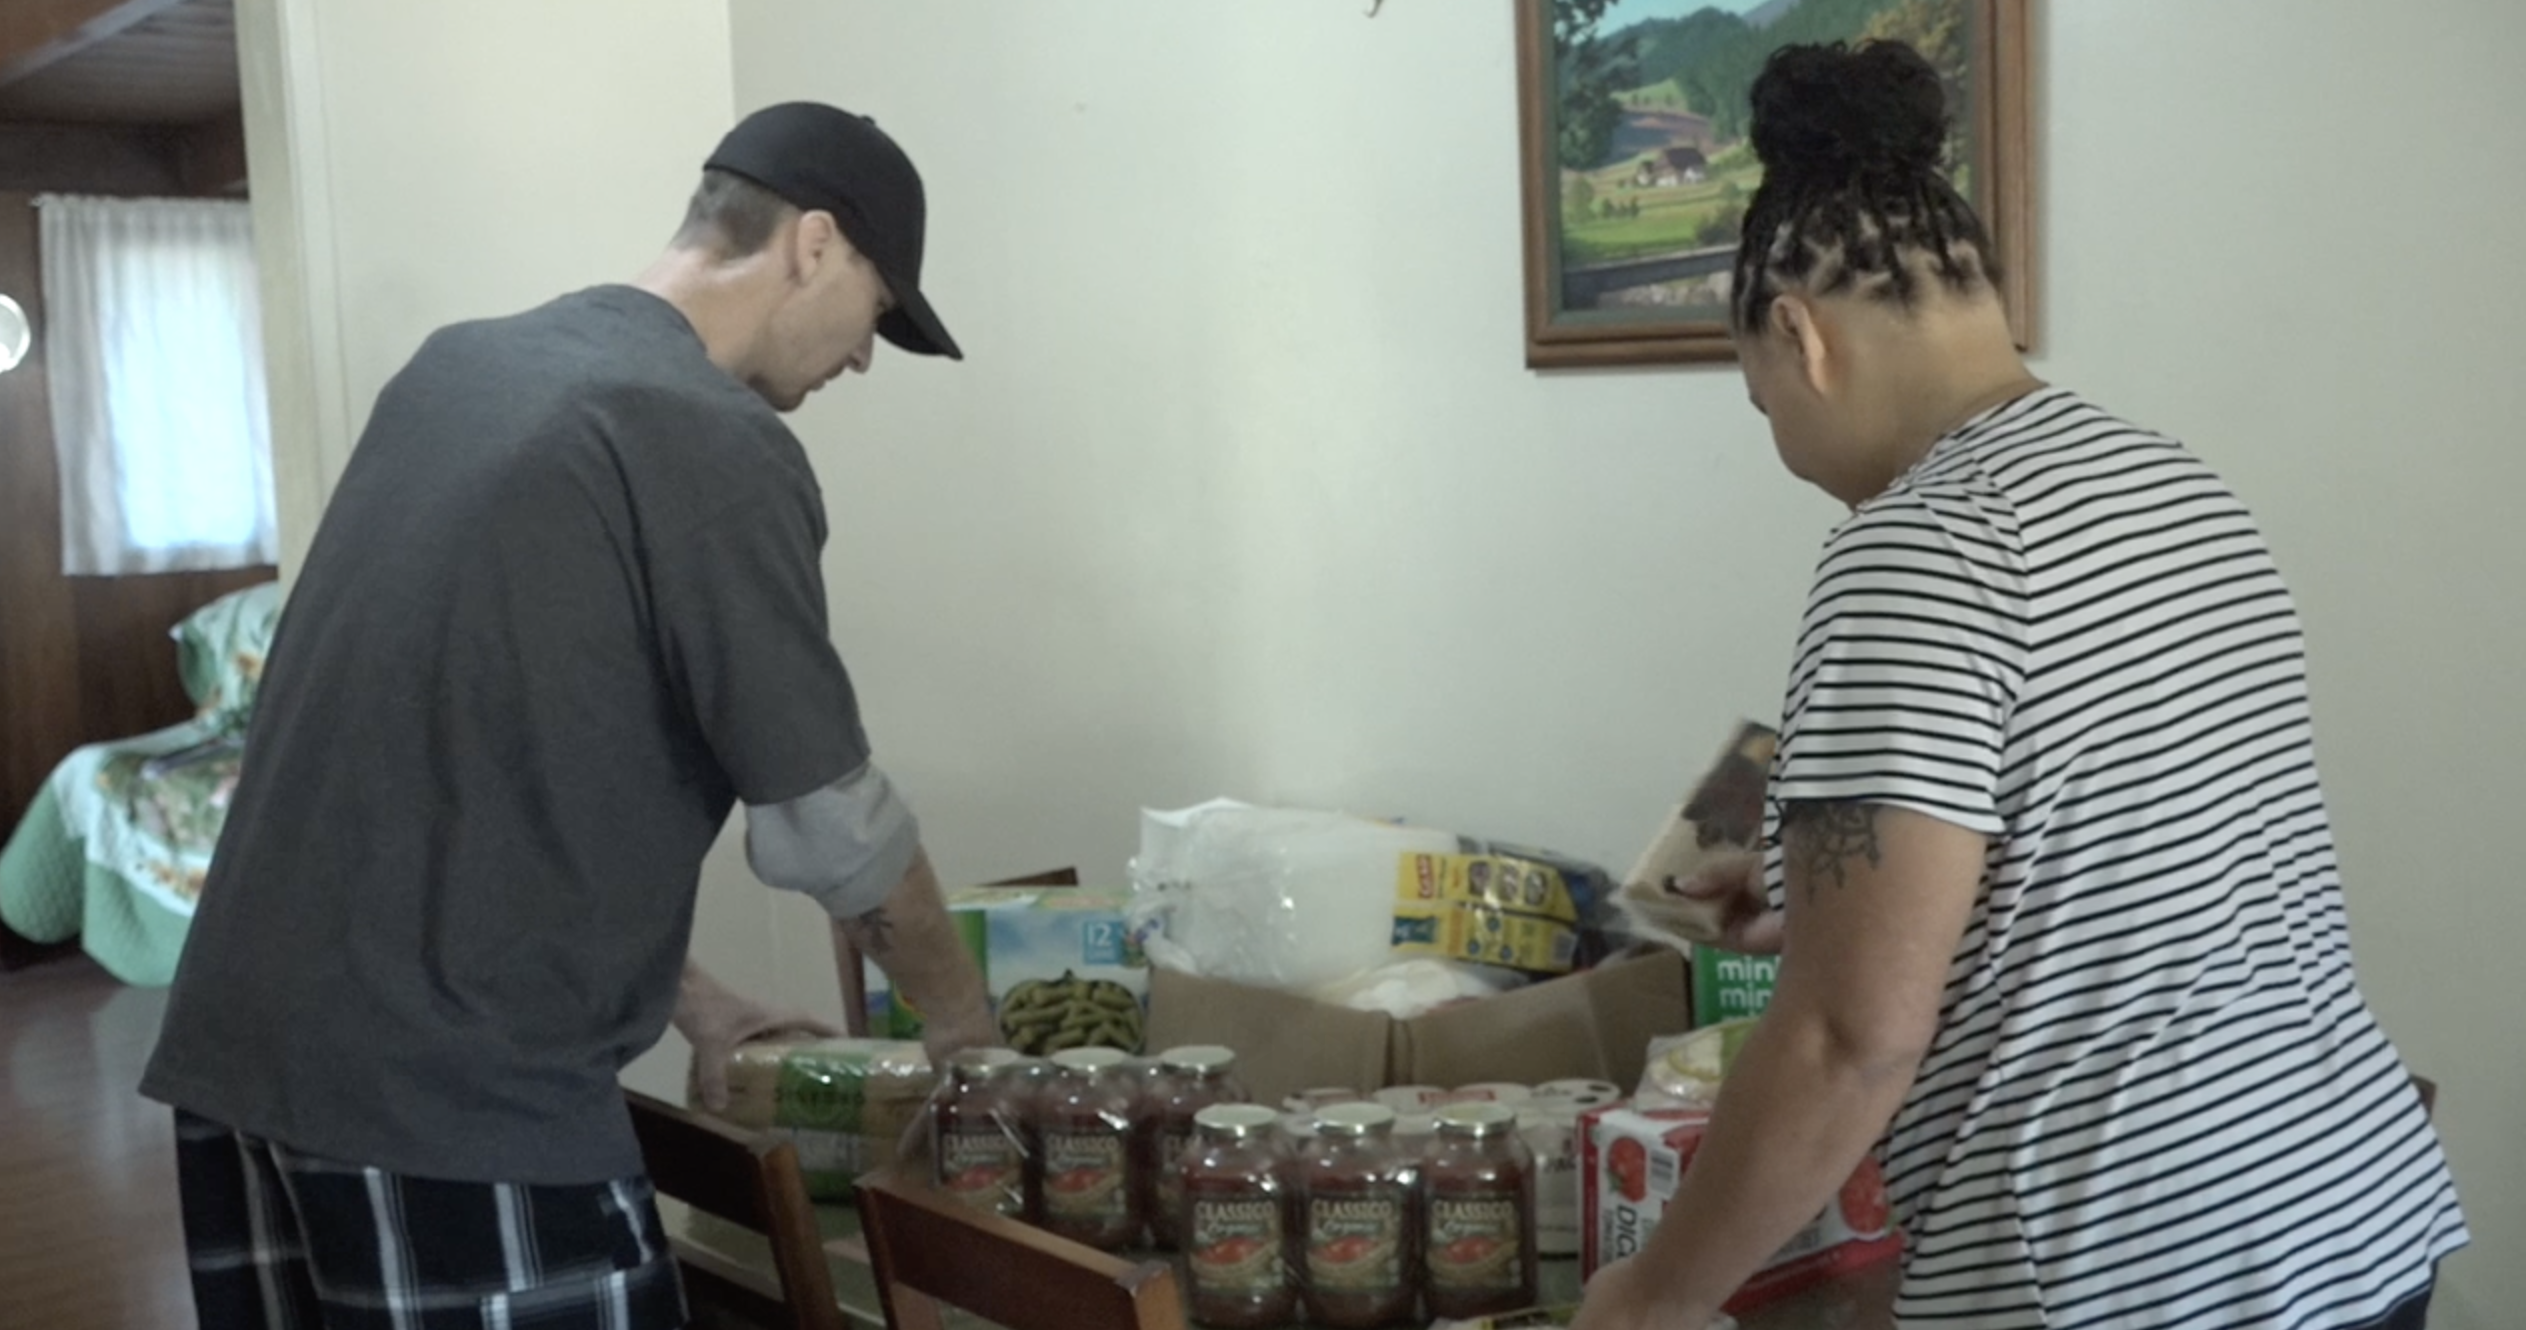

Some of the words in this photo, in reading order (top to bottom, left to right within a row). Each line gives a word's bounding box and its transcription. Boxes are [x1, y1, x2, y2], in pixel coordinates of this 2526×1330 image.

[1087, 923, 1113, 947] 12
[1719, 982, 1773, 1008] min
[1194, 1200, 1275, 1220] CLASSICO
[1311, 1199, 1392, 1220] CLASSICO
[1432, 1199, 1514, 1220] CLASSICO
